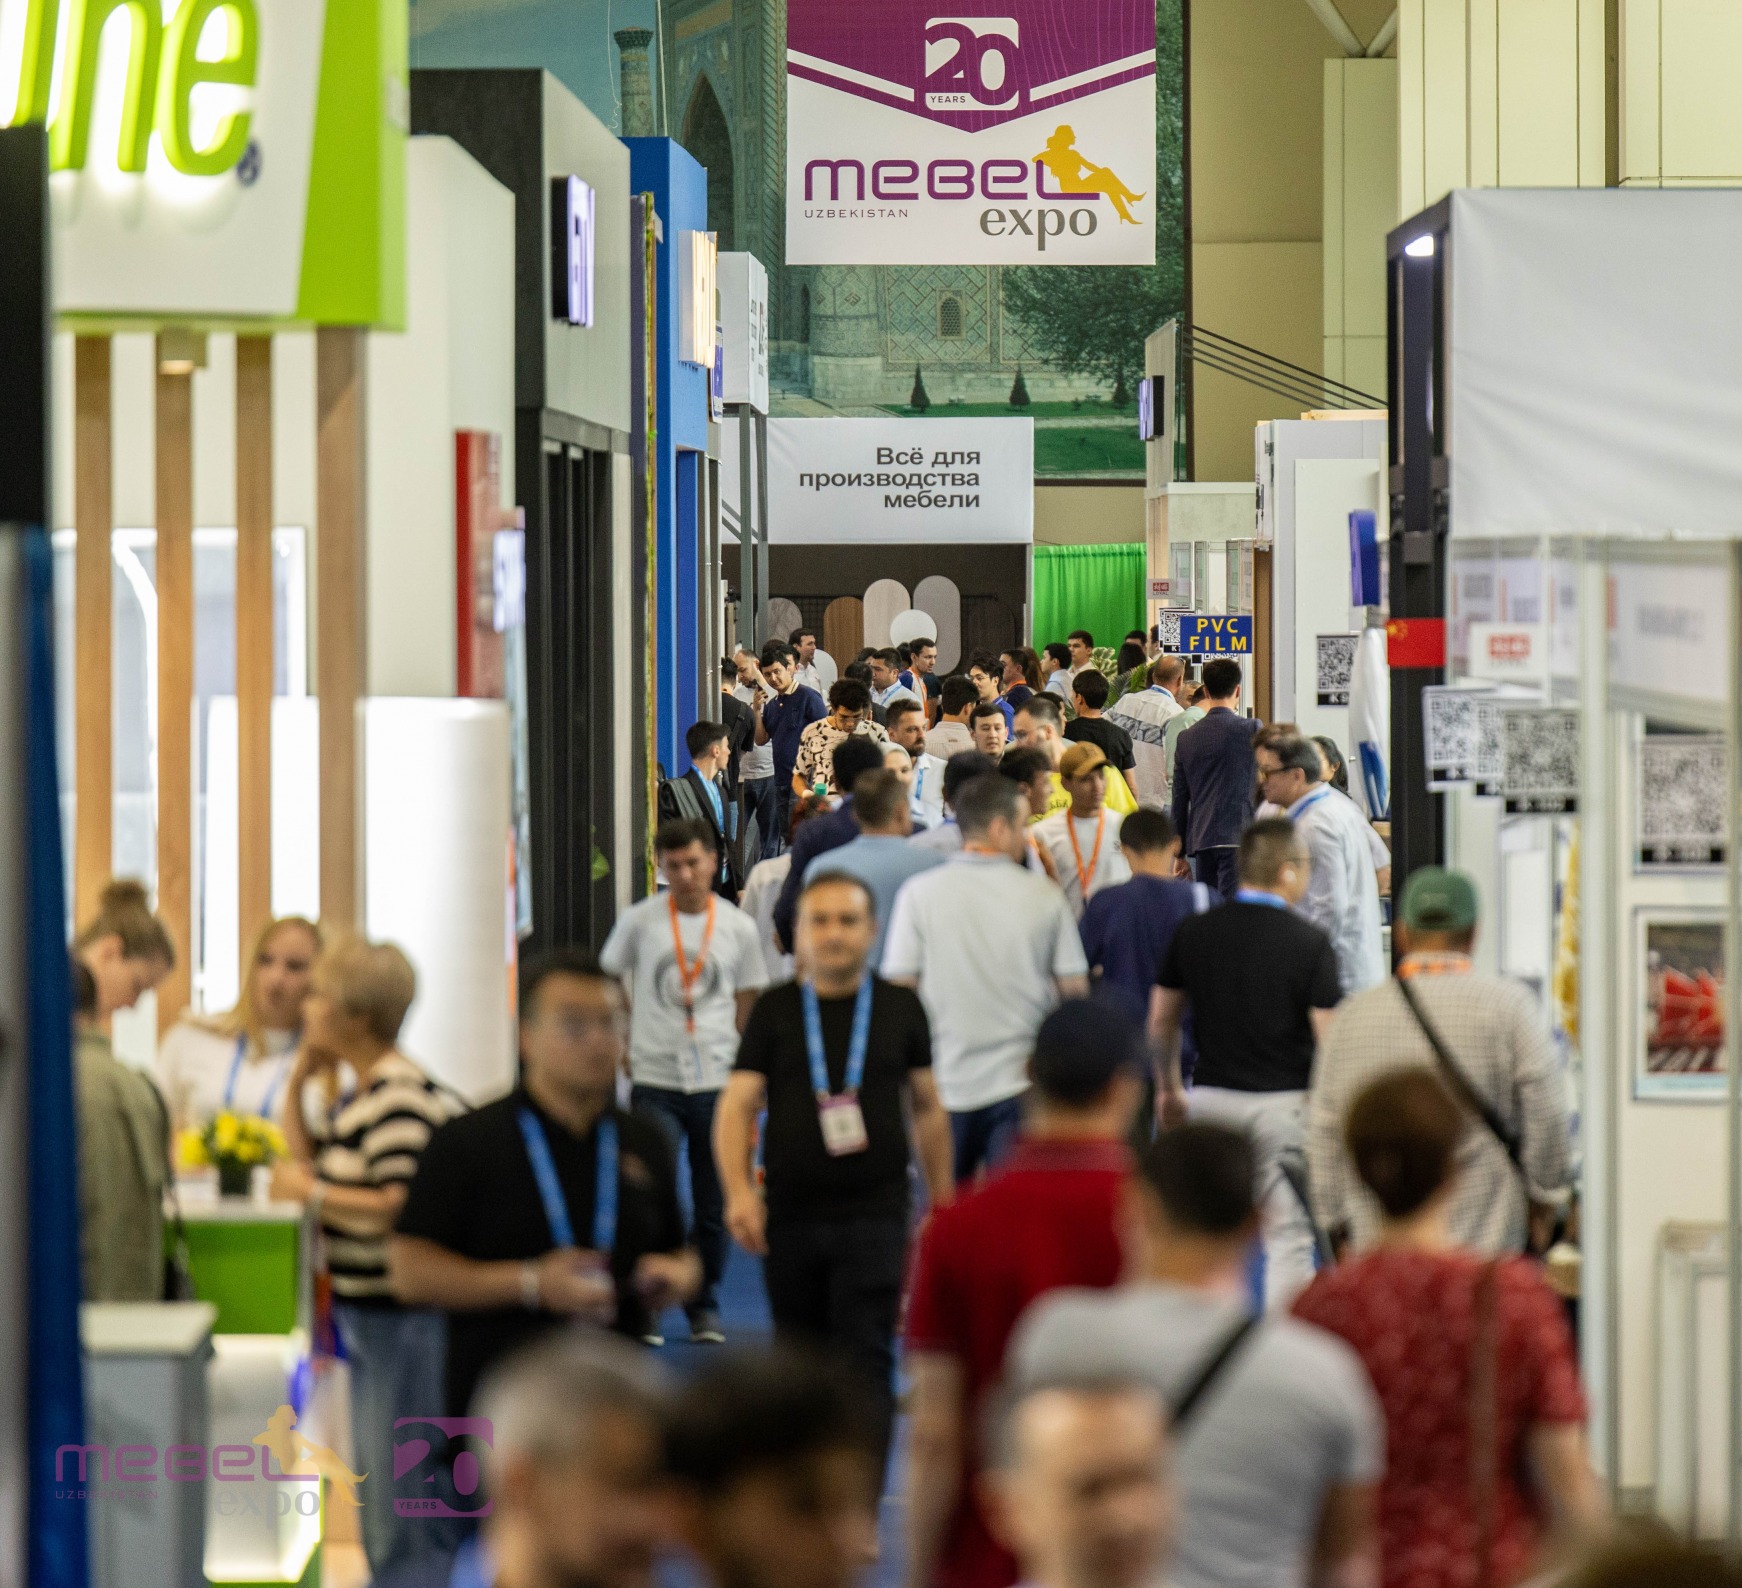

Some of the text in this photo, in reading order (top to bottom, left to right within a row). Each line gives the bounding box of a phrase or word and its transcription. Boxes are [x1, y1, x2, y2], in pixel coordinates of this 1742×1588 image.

[925, 22, 1019, 106] 20
[930, 95, 967, 104] YEARS
[804, 208, 908, 219] UZBEKISTAN
[979, 207, 1098, 252] expo
[876, 446, 981, 468] Всё для
[799, 472, 980, 492] производства
[884, 489, 980, 509] мебели
[1197, 618, 1238, 633] PVC
[1189, 636, 1247, 651] FILM
